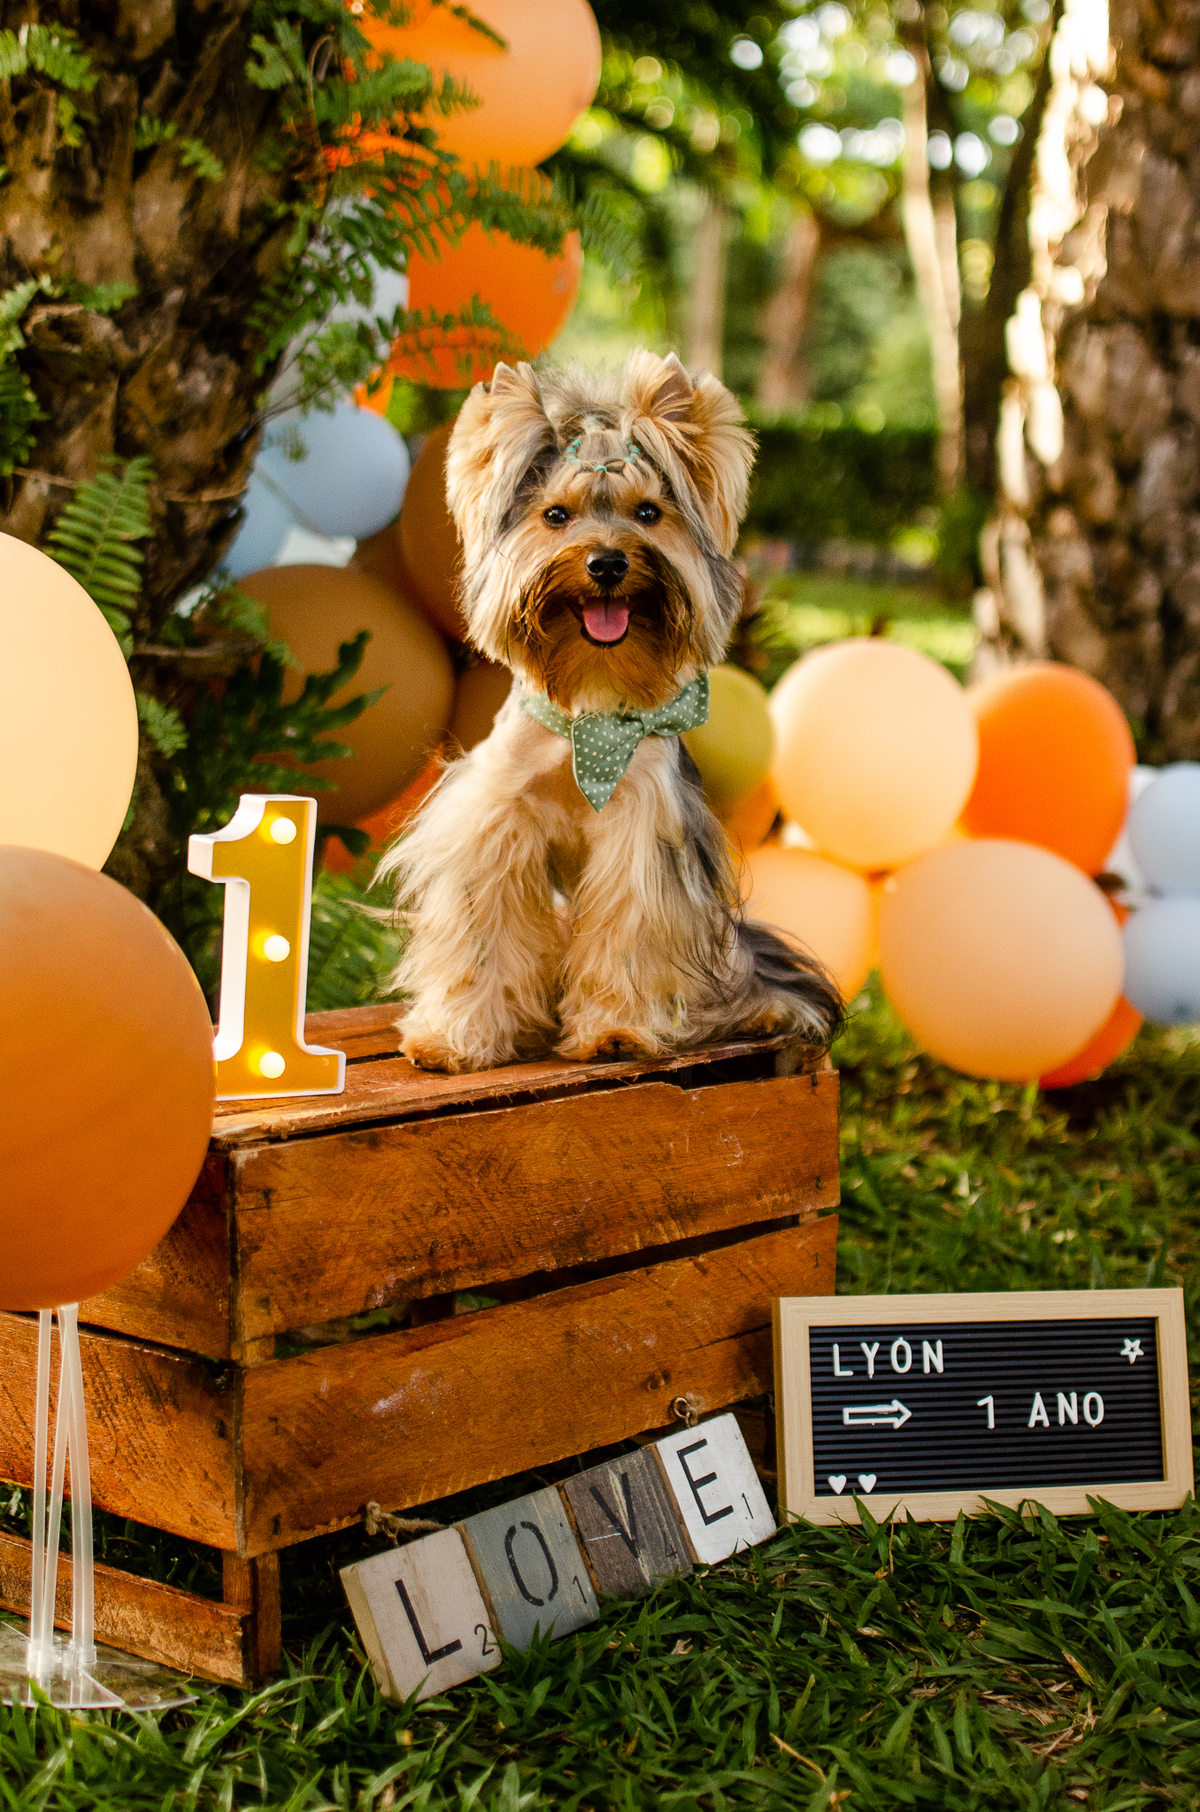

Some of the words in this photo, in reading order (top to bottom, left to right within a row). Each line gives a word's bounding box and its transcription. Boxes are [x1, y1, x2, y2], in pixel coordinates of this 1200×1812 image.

[187, 793, 347, 1102] 1
[832, 1336, 945, 1379] LYON
[977, 1395, 996, 1430] 1
[1027, 1391, 1105, 1428] ANO
[395, 1438, 734, 1666] LOVE
[474, 1623, 496, 1657] 2
